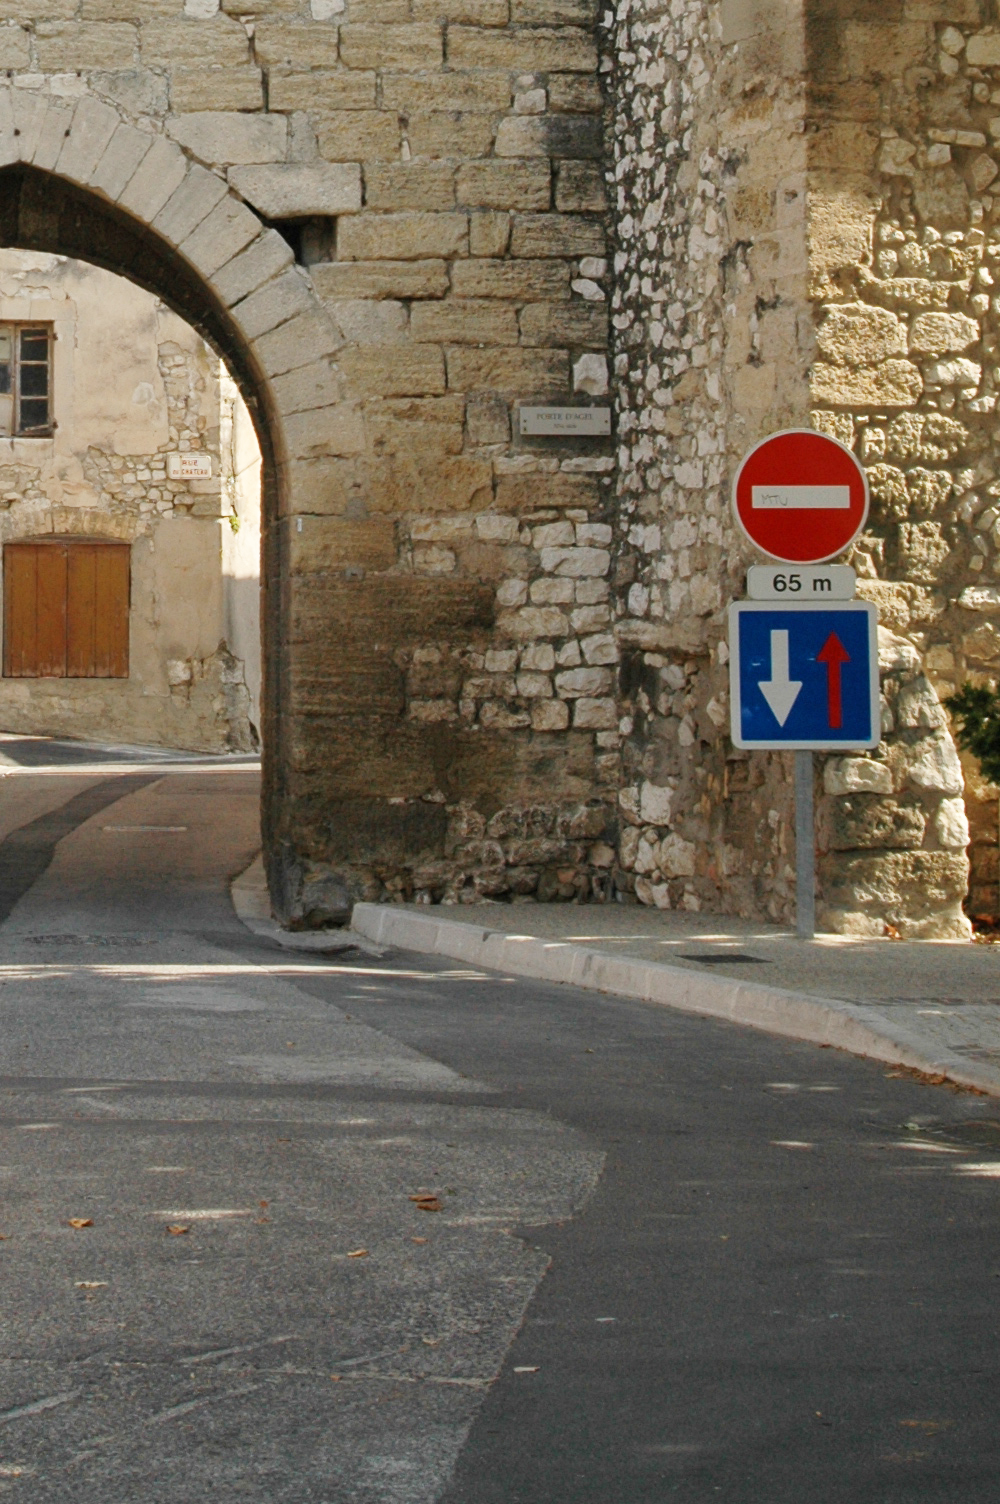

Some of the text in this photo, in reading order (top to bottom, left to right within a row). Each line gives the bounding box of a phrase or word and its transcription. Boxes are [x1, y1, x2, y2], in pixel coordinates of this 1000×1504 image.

[536, 413, 563, 421] PORTE
[181, 459, 198, 467] RUE
[773, 574, 832, 592] 65 m
